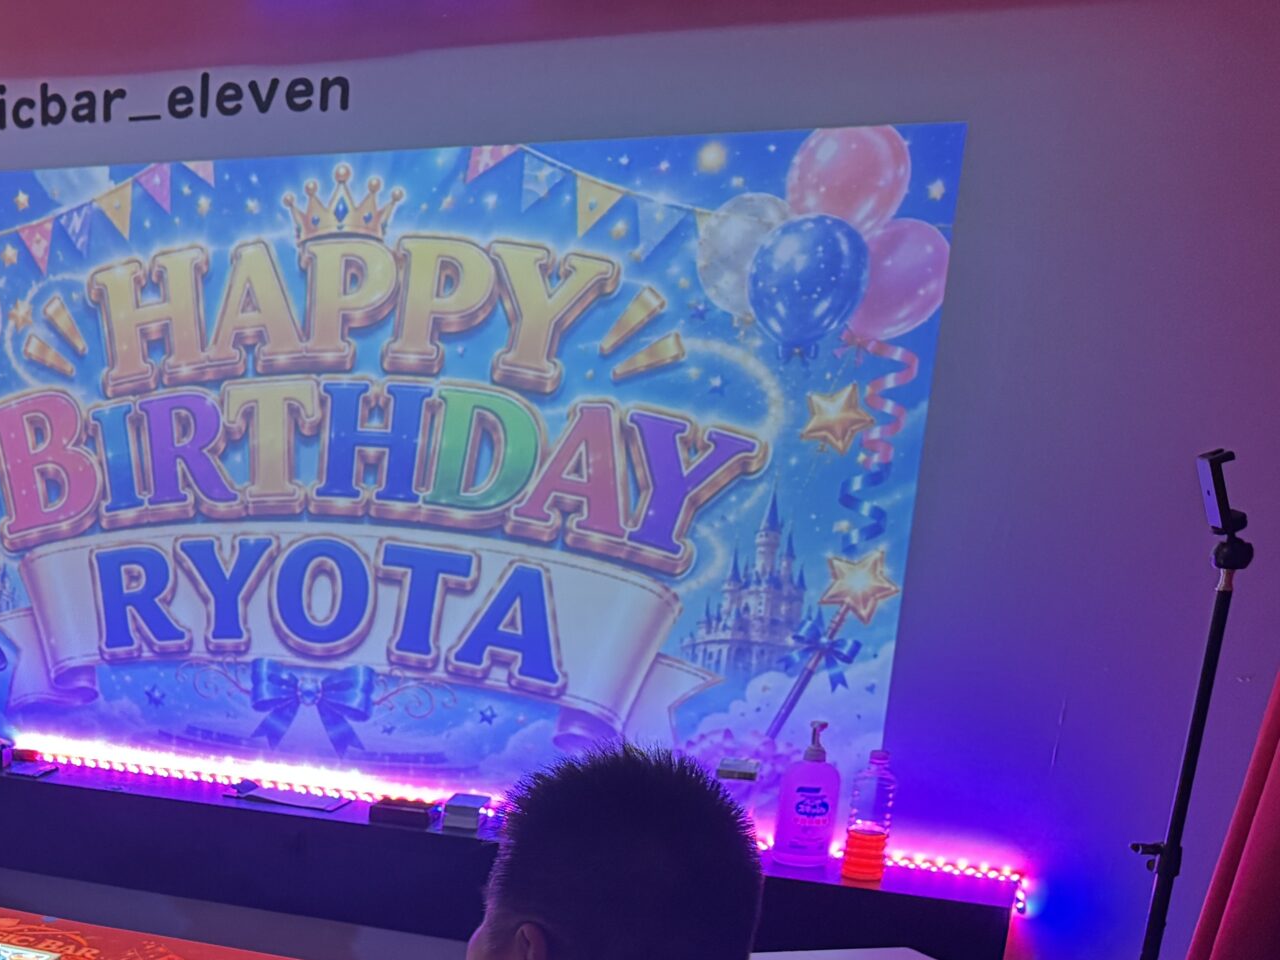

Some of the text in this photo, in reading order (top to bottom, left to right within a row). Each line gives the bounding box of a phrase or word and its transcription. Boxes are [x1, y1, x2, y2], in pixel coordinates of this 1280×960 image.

[88, 234, 620, 397] HAPPY
[92, 535, 566, 696] RYOTA
[36, 937, 100, 960] BAR
